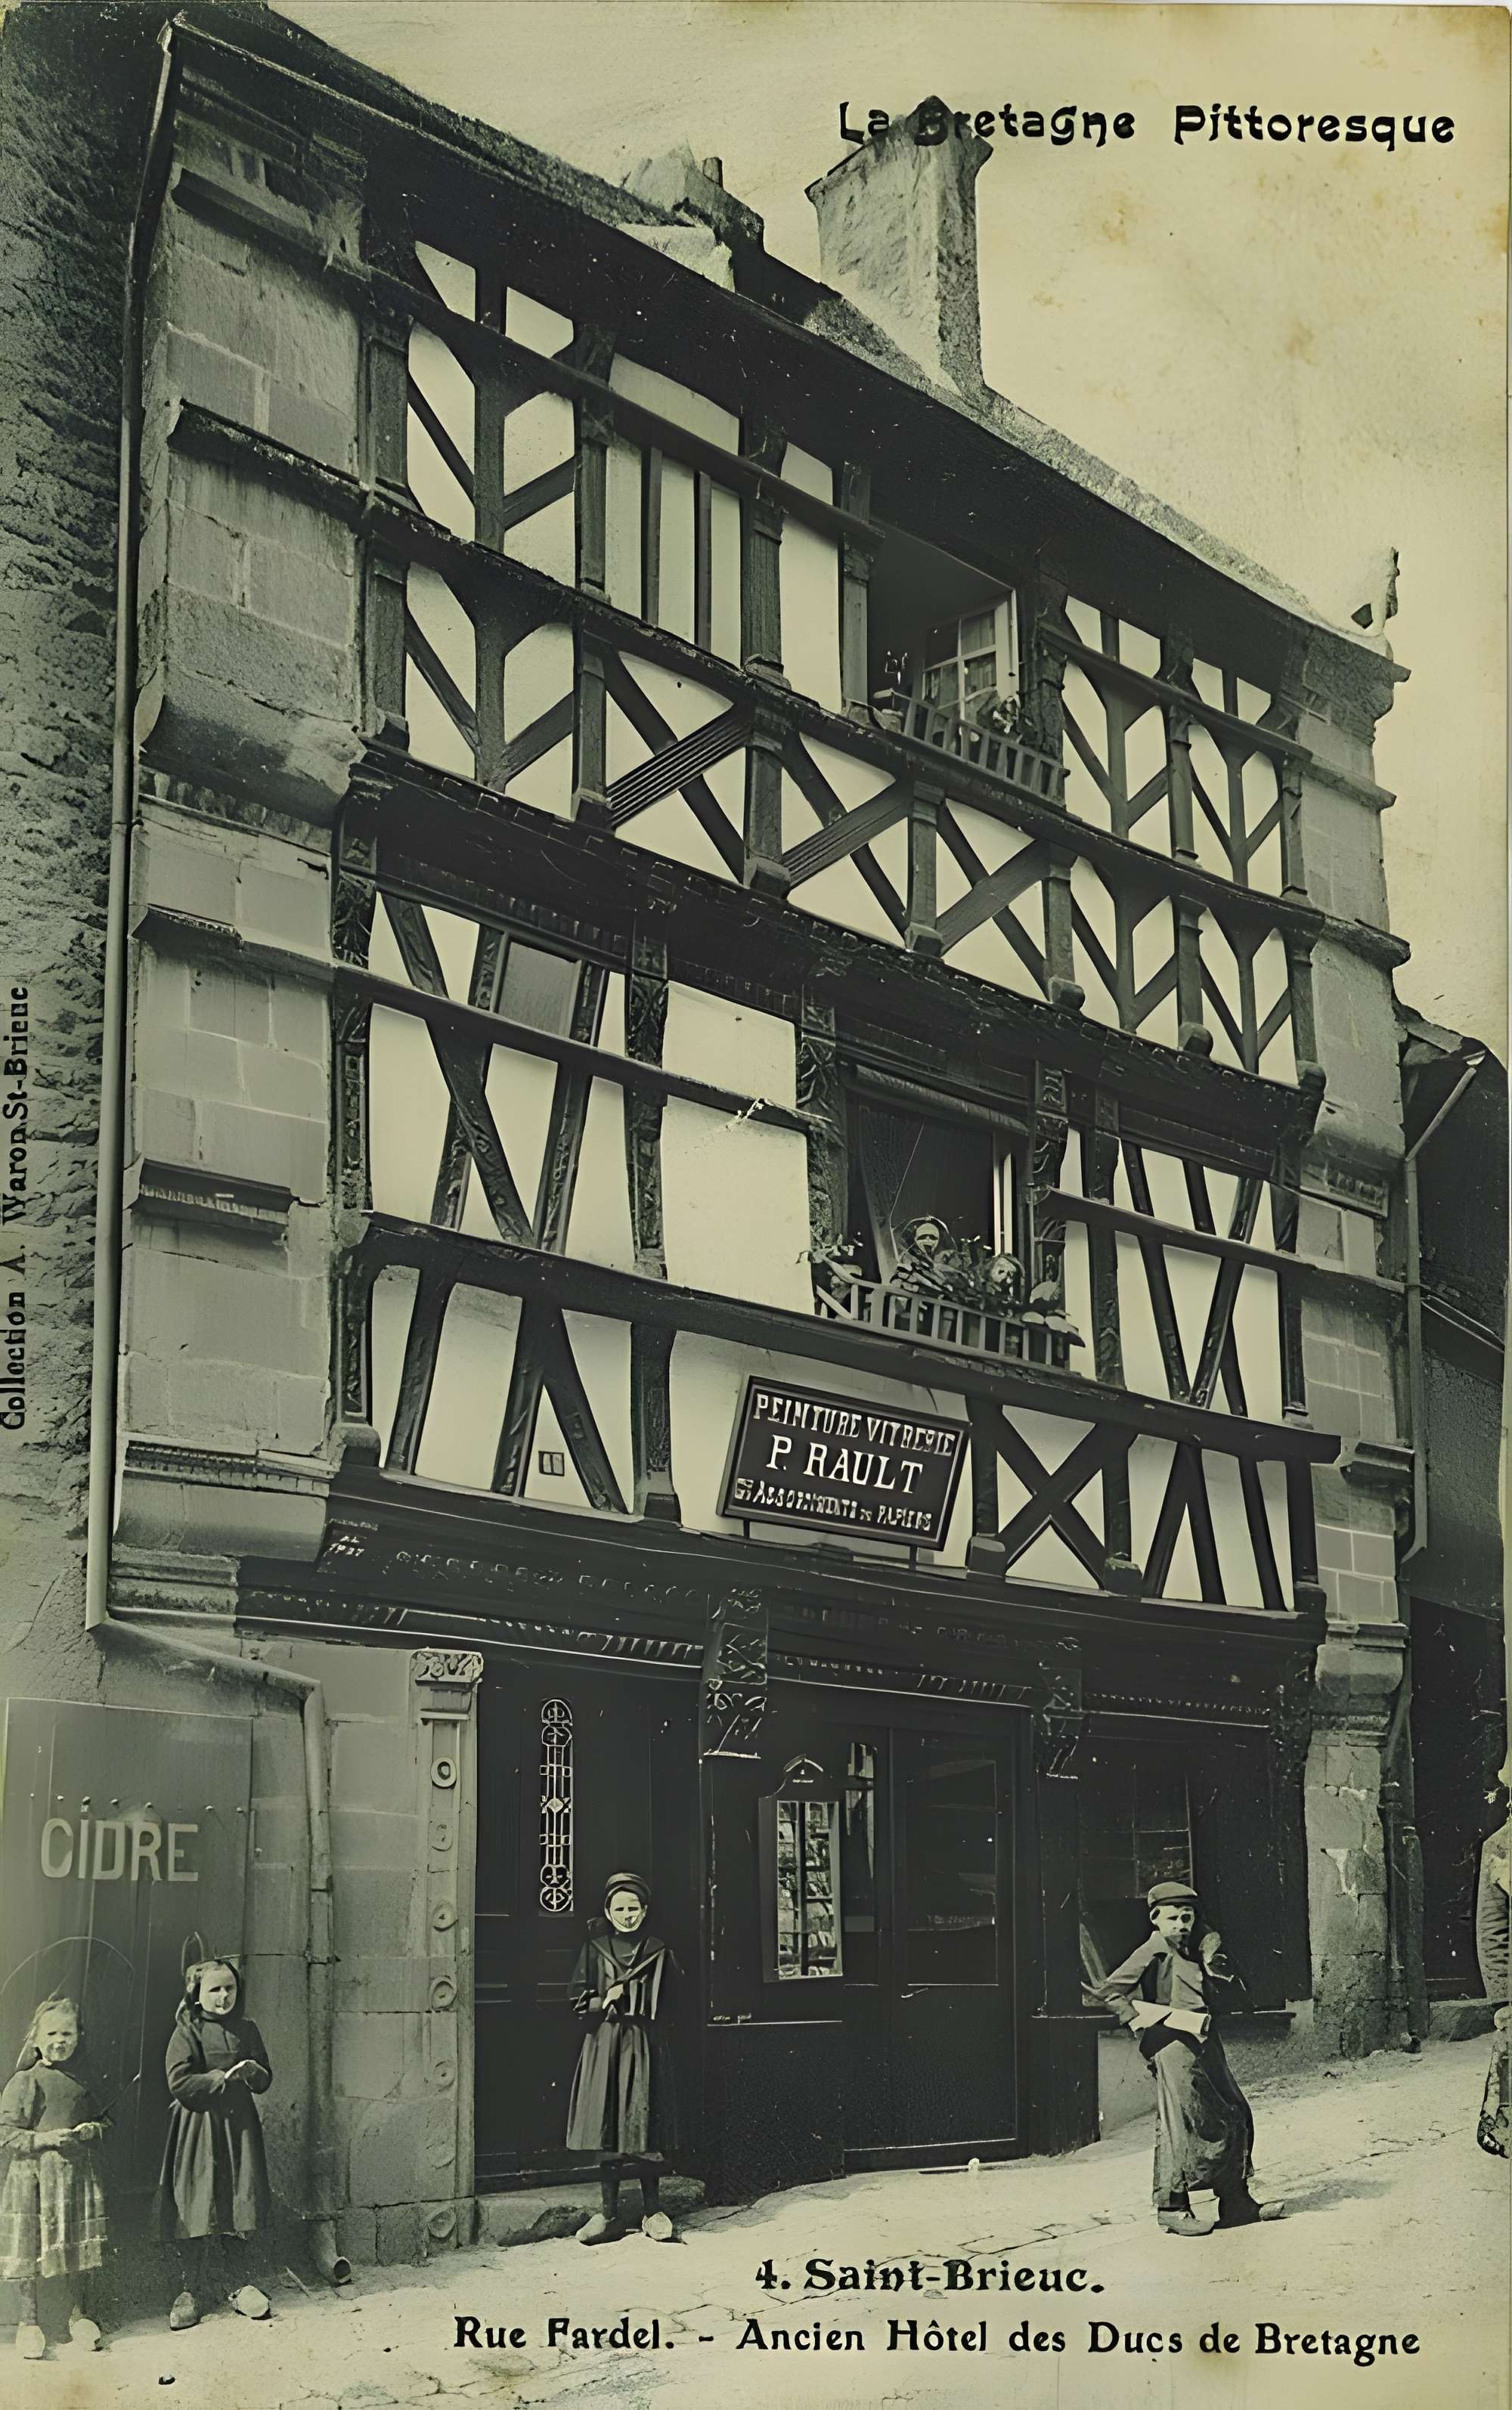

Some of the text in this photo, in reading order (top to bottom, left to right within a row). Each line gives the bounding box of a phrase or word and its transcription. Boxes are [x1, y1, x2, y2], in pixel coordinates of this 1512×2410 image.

[753, 1393, 862, 1438] PEINTURE
[803, 1442, 923, 1495] RAULT
[41, 1818, 199, 1882] CIDRE
